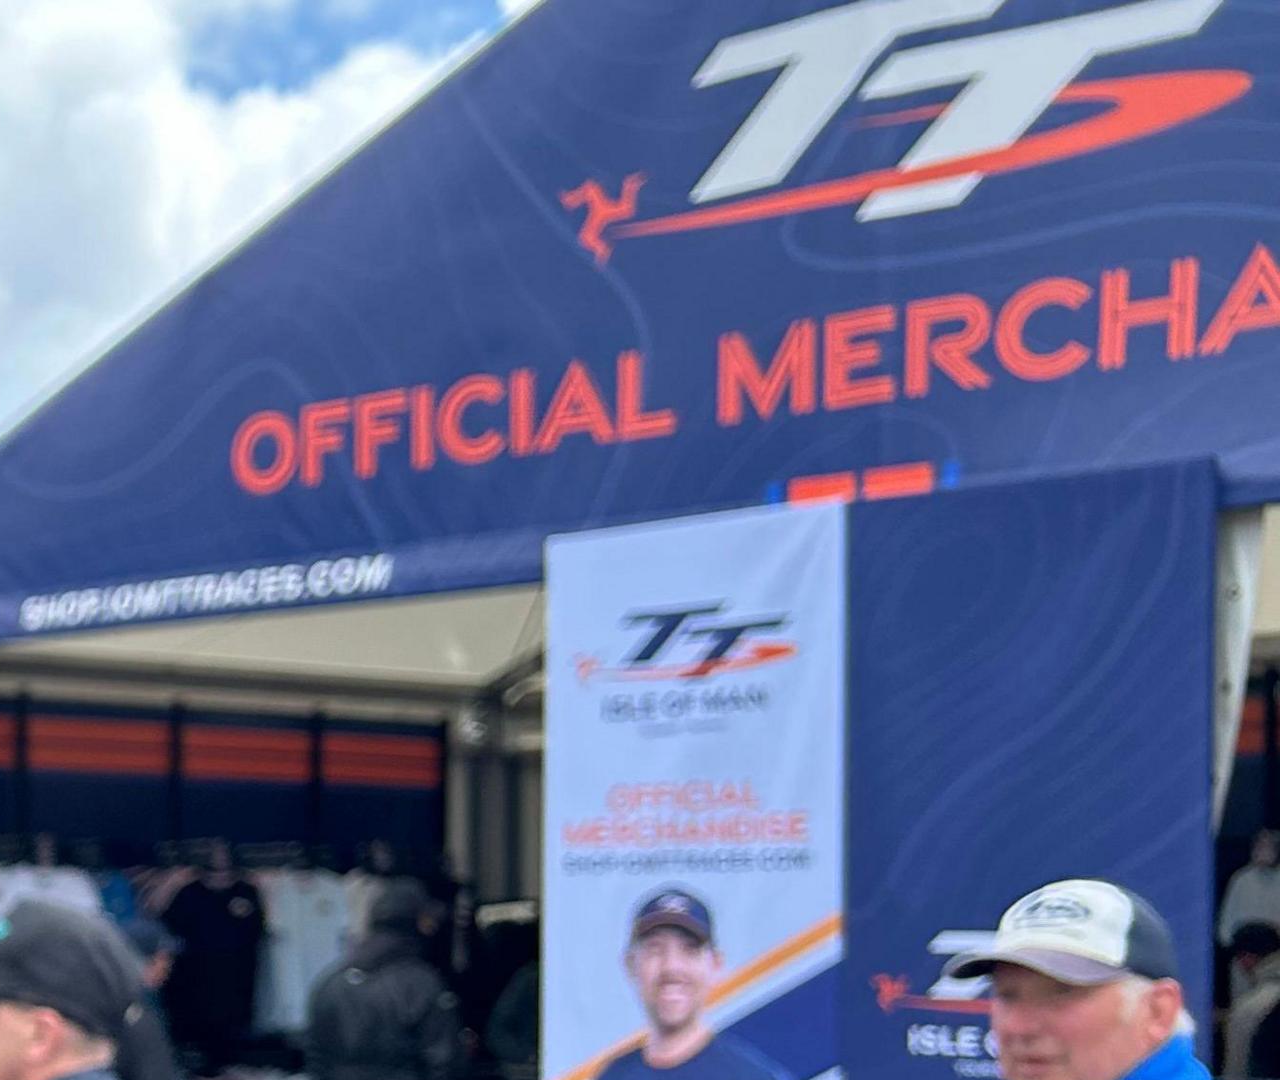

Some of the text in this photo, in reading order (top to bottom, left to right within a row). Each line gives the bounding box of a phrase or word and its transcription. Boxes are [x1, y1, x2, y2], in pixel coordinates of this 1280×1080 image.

[689, 0, 1225, 222] TT
[230, 350, 677, 495] OFFICIAL
[907, 1024, 982, 1056] ISLE
